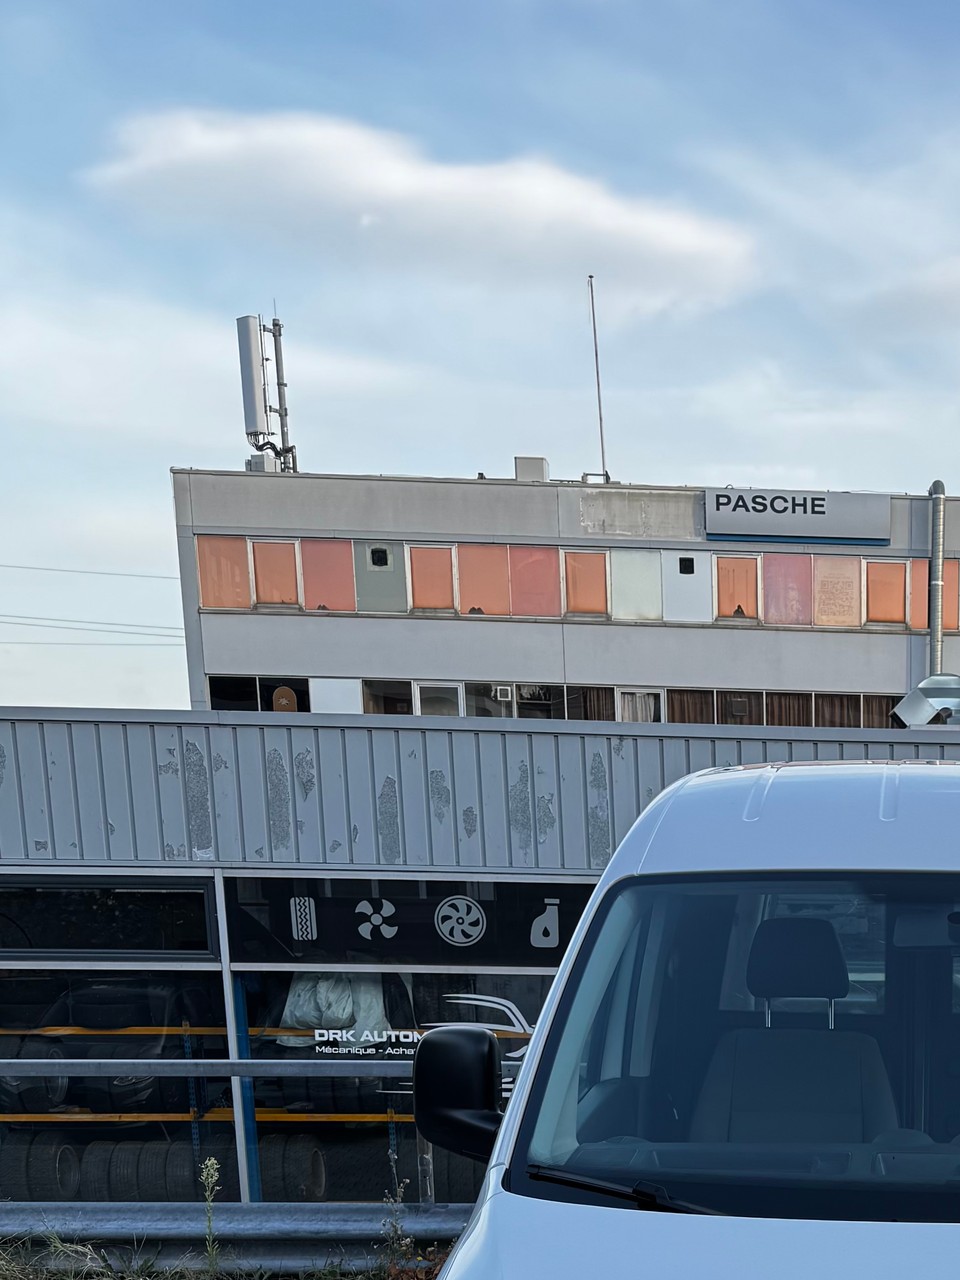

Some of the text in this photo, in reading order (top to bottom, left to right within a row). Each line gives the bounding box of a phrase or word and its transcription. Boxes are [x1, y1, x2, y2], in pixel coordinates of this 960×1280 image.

[715, 494, 826, 515] PASCHE
[314, 1029, 356, 1041] DRK
[315, 1045, 376, 1055] Mécanique
[385, 1046, 416, 1055] Acha
